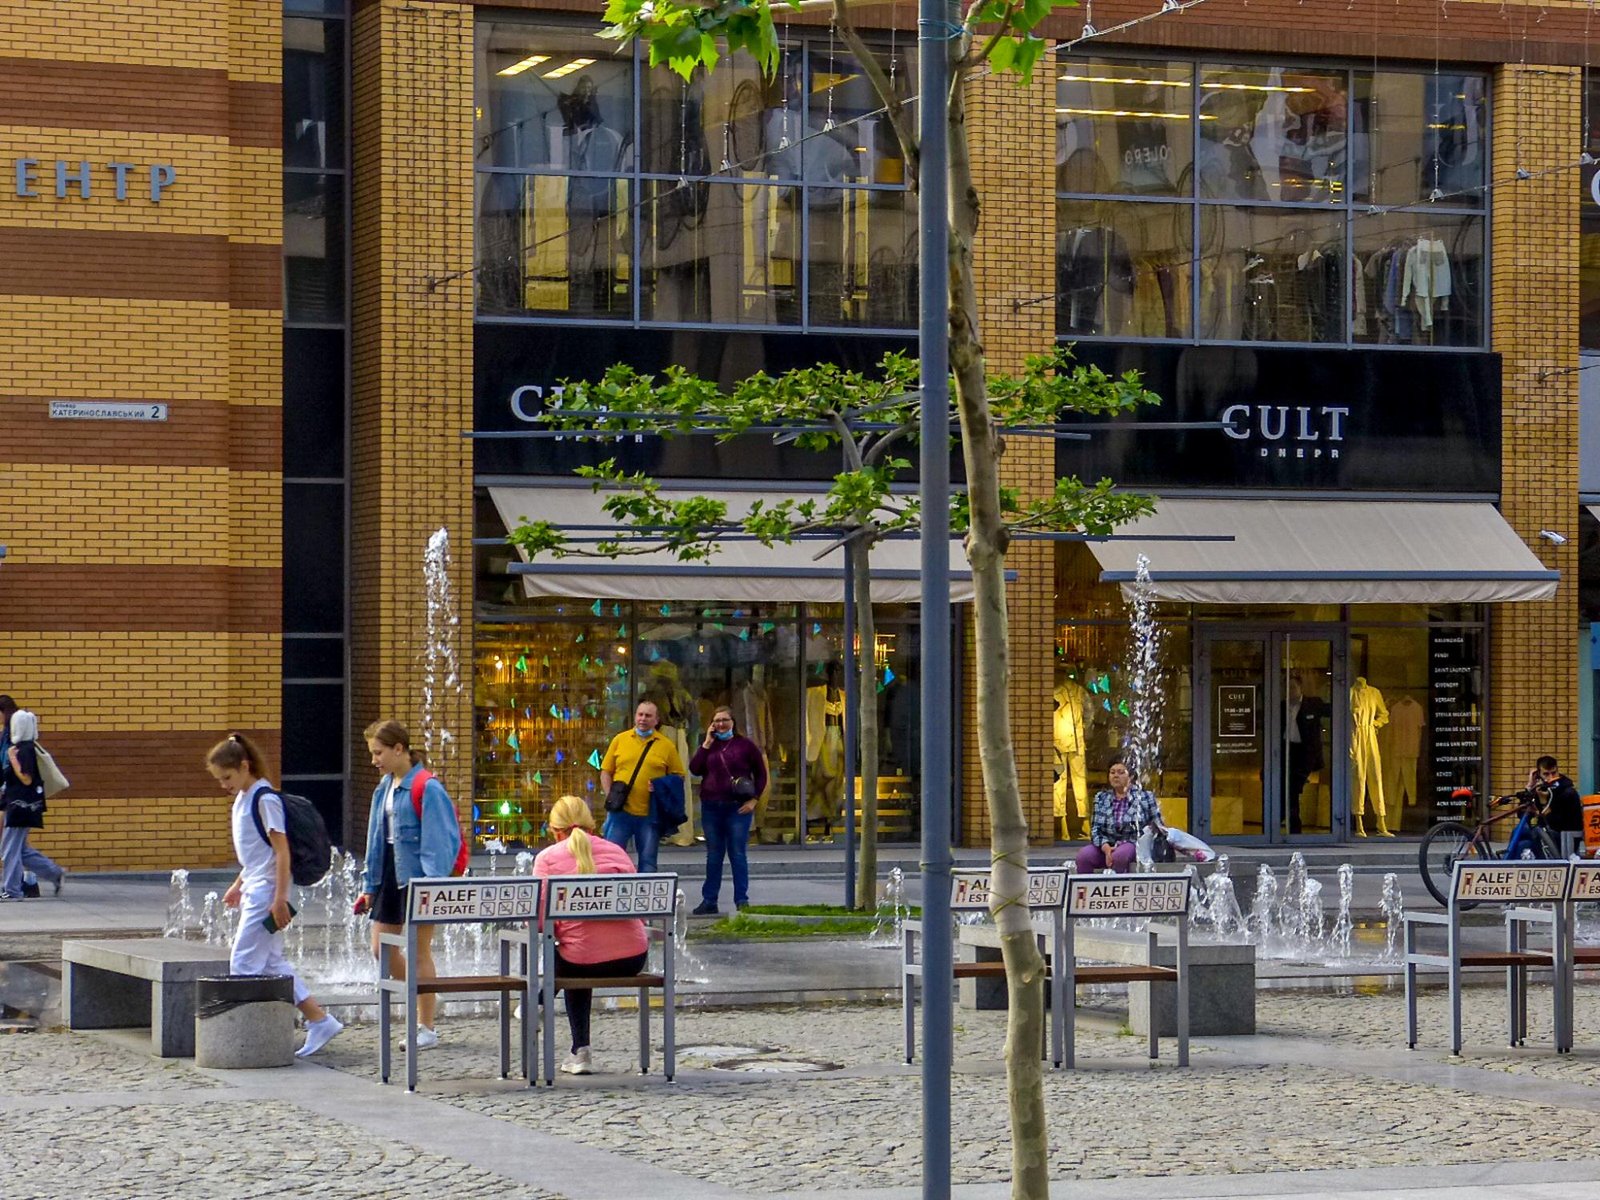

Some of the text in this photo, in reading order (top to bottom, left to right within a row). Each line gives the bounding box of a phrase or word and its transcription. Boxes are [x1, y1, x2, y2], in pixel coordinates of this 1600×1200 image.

[16, 158, 177, 203] ЕНТР
[52, 405, 160, 419] КАТЕРИНОСЛАВСЬКИЙ 2
[1222, 404, 1349, 441] CULT
[1261, 448, 1339, 458] DNEPR
[1477, 872, 1514, 884] ALEF
[971, 879, 990, 890] AL
[434, 889, 477, 902] ALEF
[571, 885, 613, 898] ALEF
[1090, 885, 1130, 897] ALEF
[1474, 886, 1512, 896] ESTATE
[969, 893, 988, 903] EST
[433, 904, 475, 915] ESTATE
[570, 900, 612, 911] ESTATE
[1089, 900, 1129, 910] ESTATE
